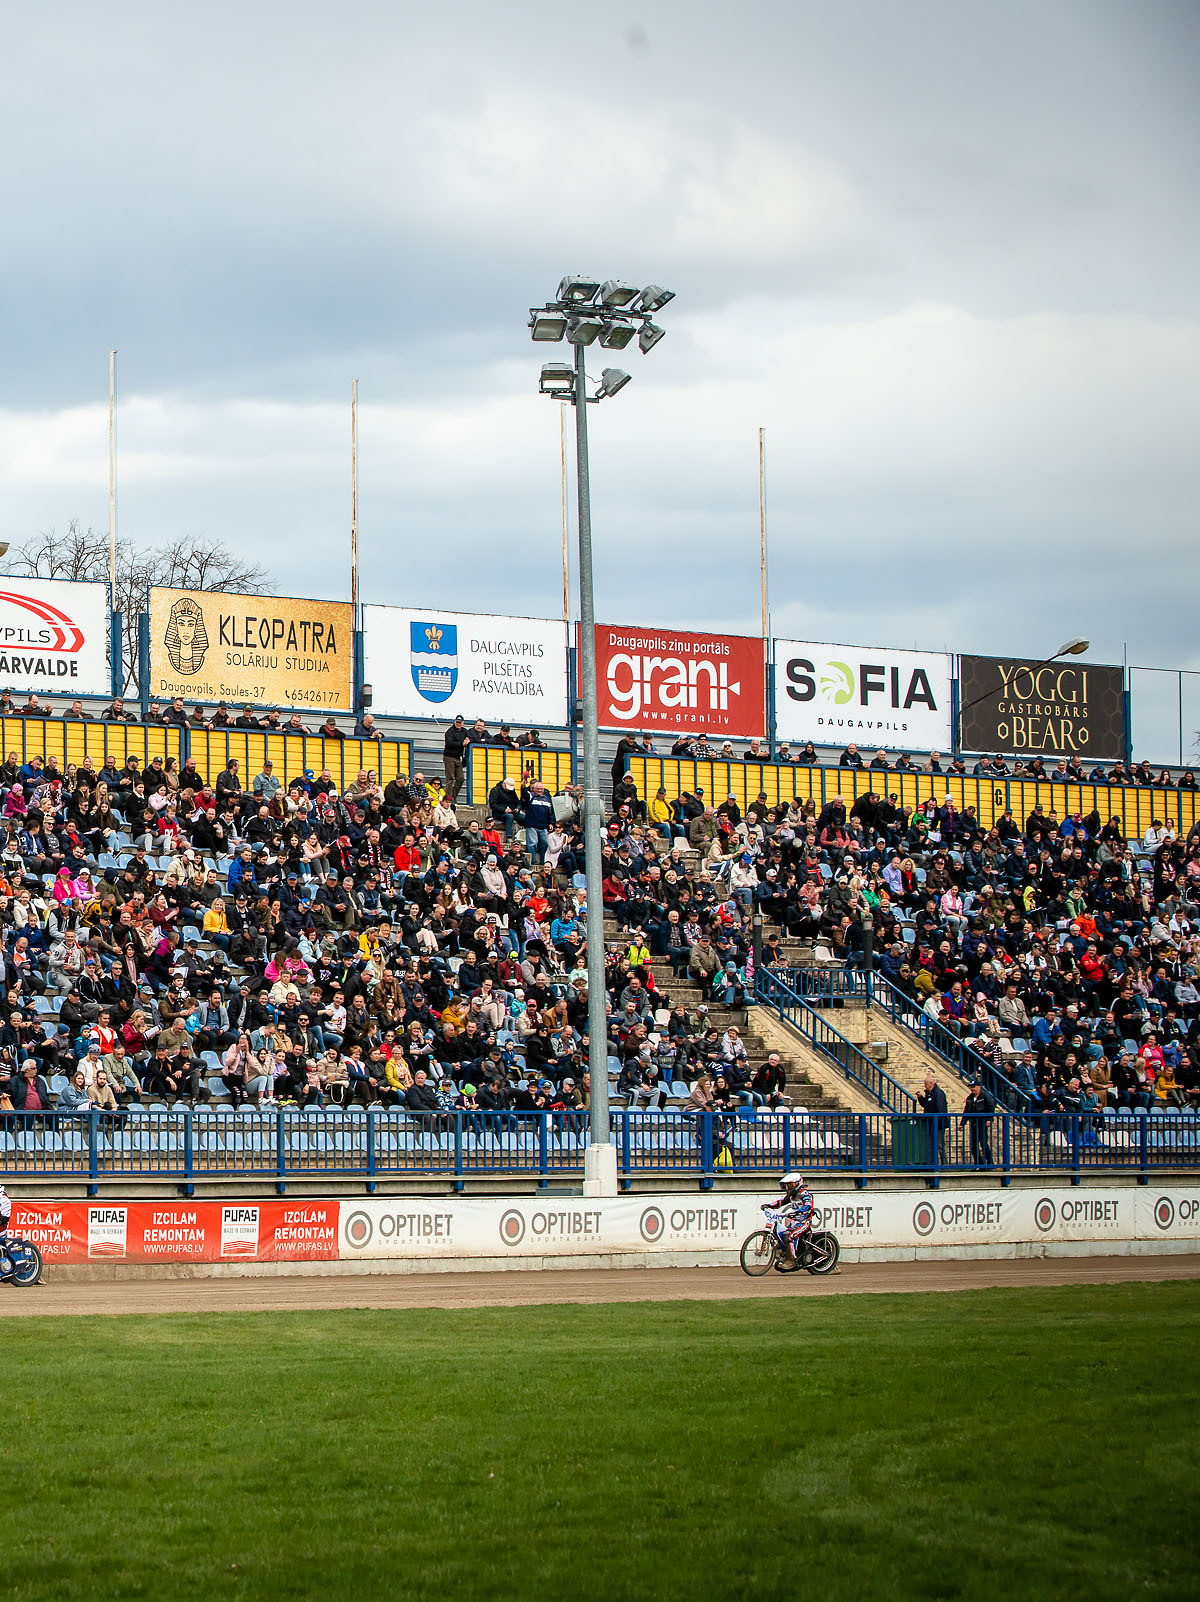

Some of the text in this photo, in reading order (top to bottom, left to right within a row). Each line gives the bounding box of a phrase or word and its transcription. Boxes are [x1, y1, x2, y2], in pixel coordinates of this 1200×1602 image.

[219, 614, 337, 654] KLEOPATRA
[470, 639, 544, 657] DAUGAVPILS
[609, 633, 730, 655] Daugavpils ziņu portāls
[226, 652, 330, 673] SOLĀRIJU STUDIJA
[484, 659, 533, 678] PILSĒTAS
[160, 680, 340, 703] Daugavpils, Saules-37 65426177
[472, 677, 544, 697] PAŠVALDĪBA
[606, 653, 728, 720] grani
[997, 665, 1088, 704] YOGGI
[642, 710, 729, 725] www.grani.lv
[998, 702, 1088, 718] GASTROBĀRS
[817, 717, 908, 731] DAUGAVPILS
[1012, 716, 1080, 750] BEAR
[995, 788, 1003, 807] G
[16, 1212, 63, 1225] IZCILAM
[90, 1210, 125, 1223] PUFAS
[152, 1212, 197, 1225] IZCILAM
[224, 1209, 258, 1222] PUFAS
[284, 1210, 327, 1224] IZCILAM
[670, 1208, 738, 1231] OPTIBET
[811, 1206, 872, 1229] OPTIBET
[941, 1202, 1003, 1225] OPTIBET
[1060, 1200, 1119, 1222] OPTIBET
[379, 1214, 453, 1237] OPTIBET
[531, 1211, 602, 1235] OPTIBET
[143, 1229, 205, 1242] REMONTAM
[274, 1227, 334, 1240] REMONTAM
[143, 1244, 205, 1254] WWW.PUFAS.LV
[274, 1241, 334, 1252] WWW.PUFAS.LV
